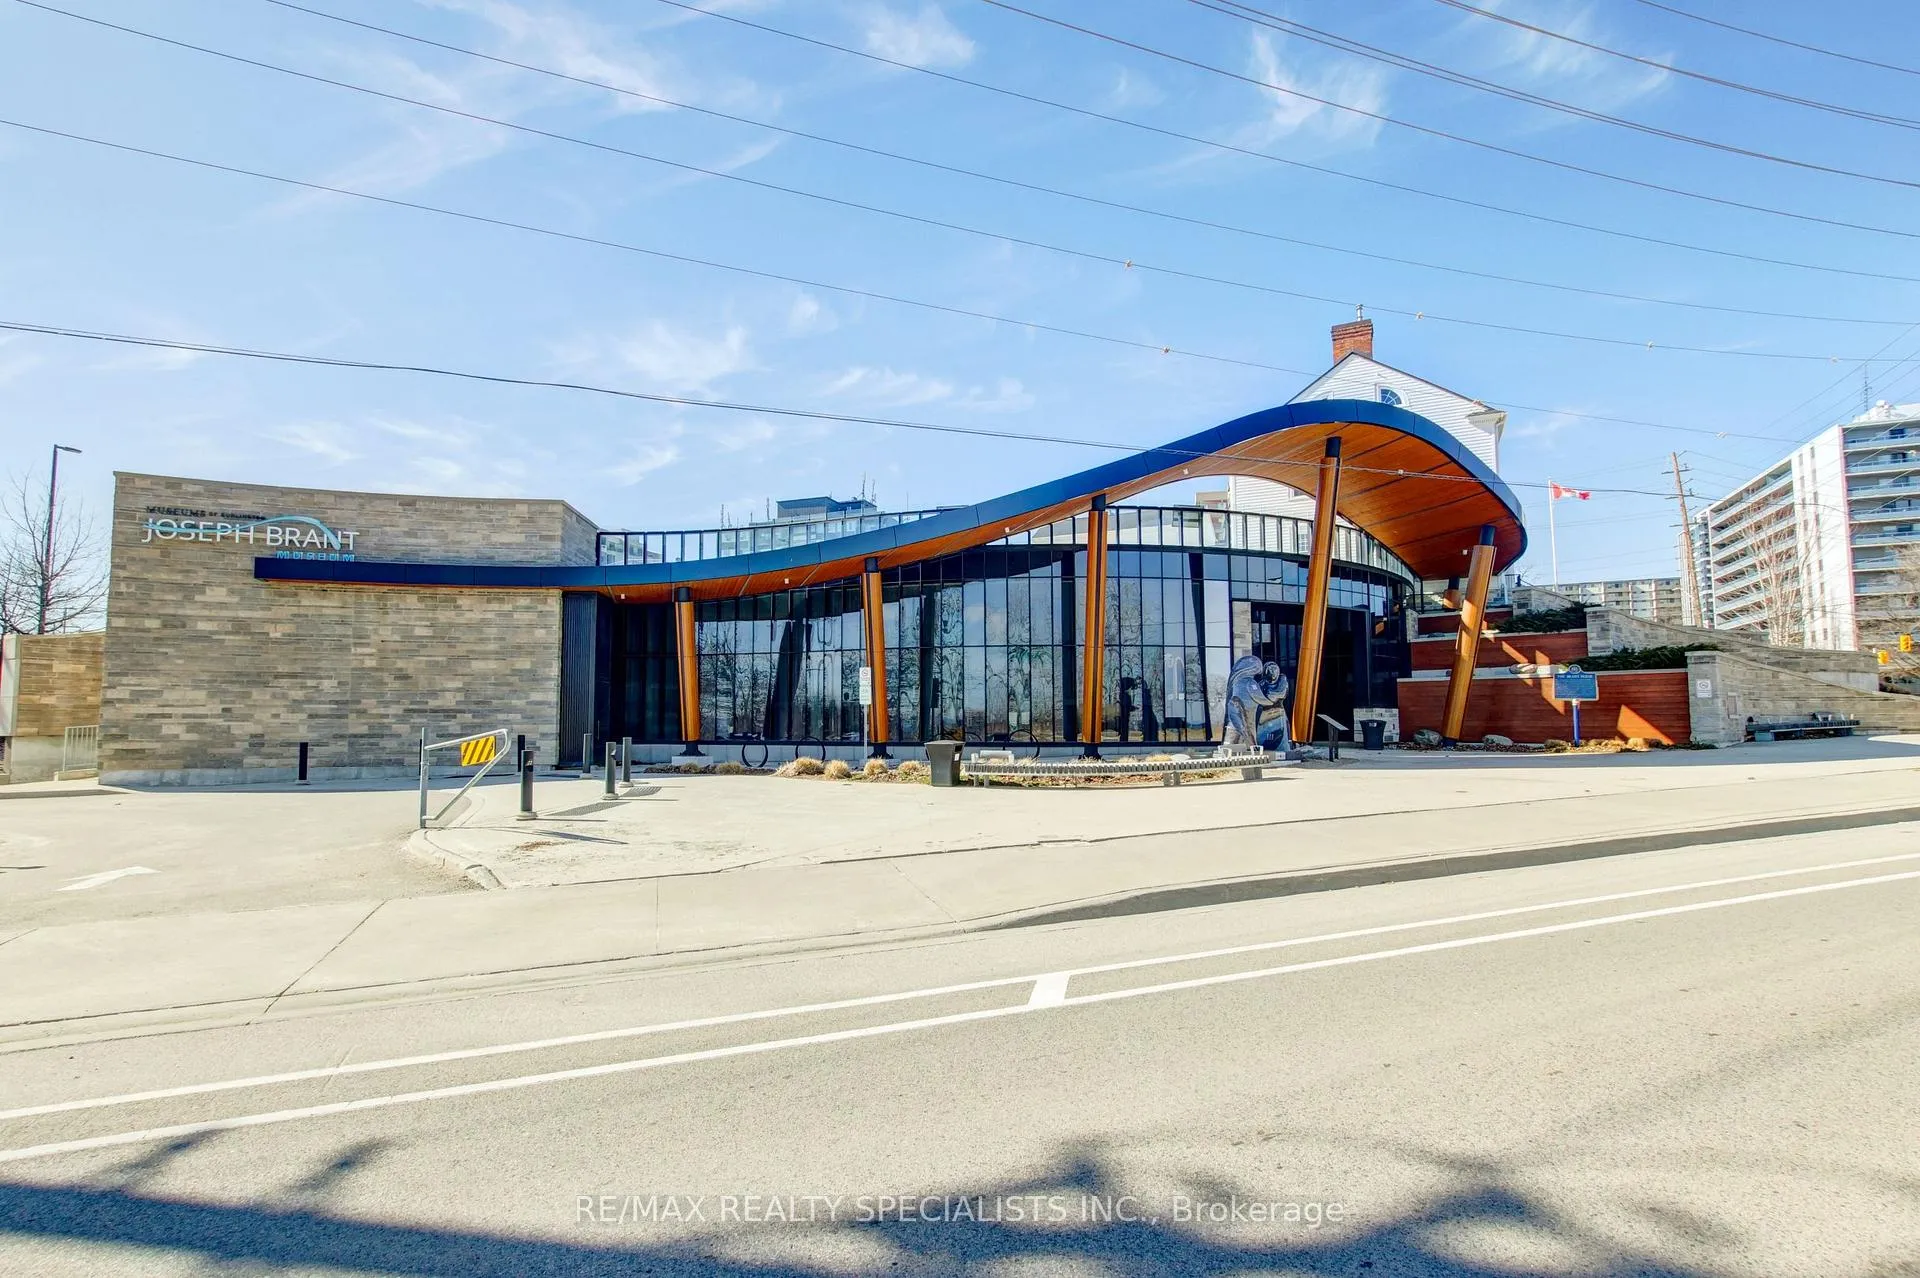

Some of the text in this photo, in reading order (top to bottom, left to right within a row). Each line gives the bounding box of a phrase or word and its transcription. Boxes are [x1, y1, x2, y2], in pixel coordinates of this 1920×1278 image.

[141, 518, 360, 550] JOSEPH BRANT
[276, 551, 355, 562] MUSEUM
